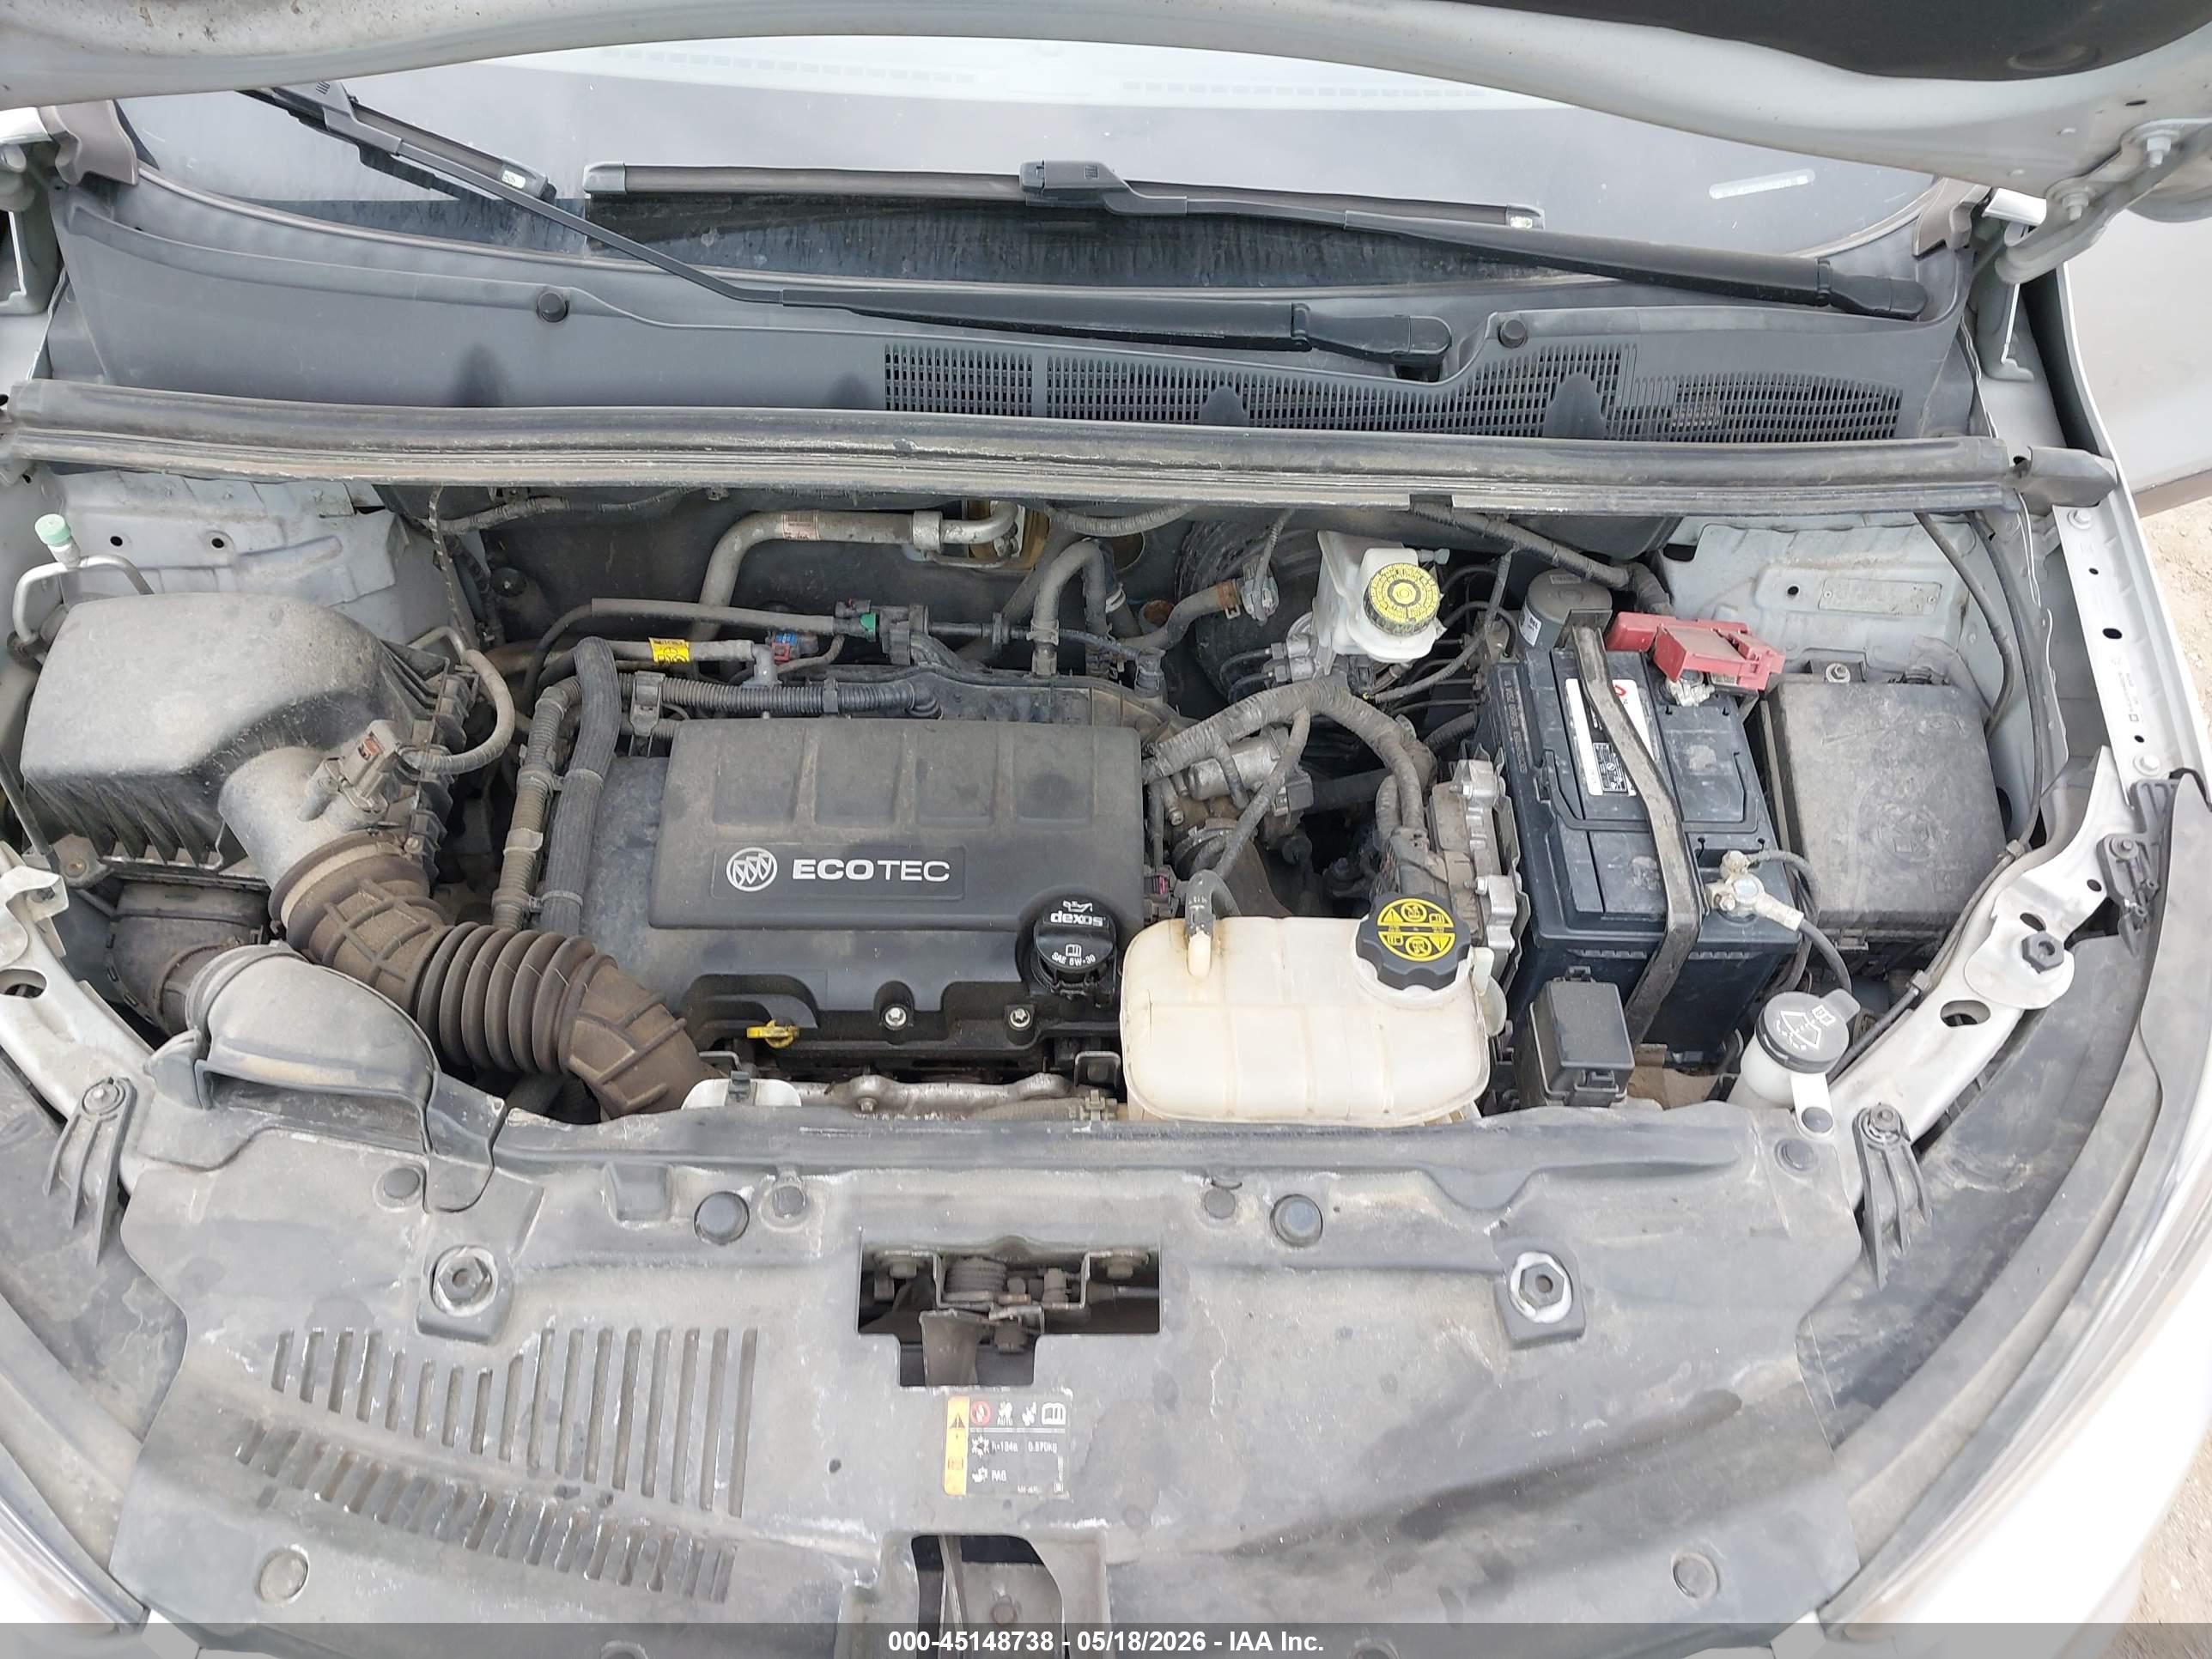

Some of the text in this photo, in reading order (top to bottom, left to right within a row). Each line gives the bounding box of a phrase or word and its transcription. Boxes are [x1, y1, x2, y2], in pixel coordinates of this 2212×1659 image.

[793, 859, 951, 882] ECOTEC
[1050, 910, 1103, 927] dexos
[1051, 951, 1066, 965] SAE
[991, 1469, 1007, 1482] PAG
